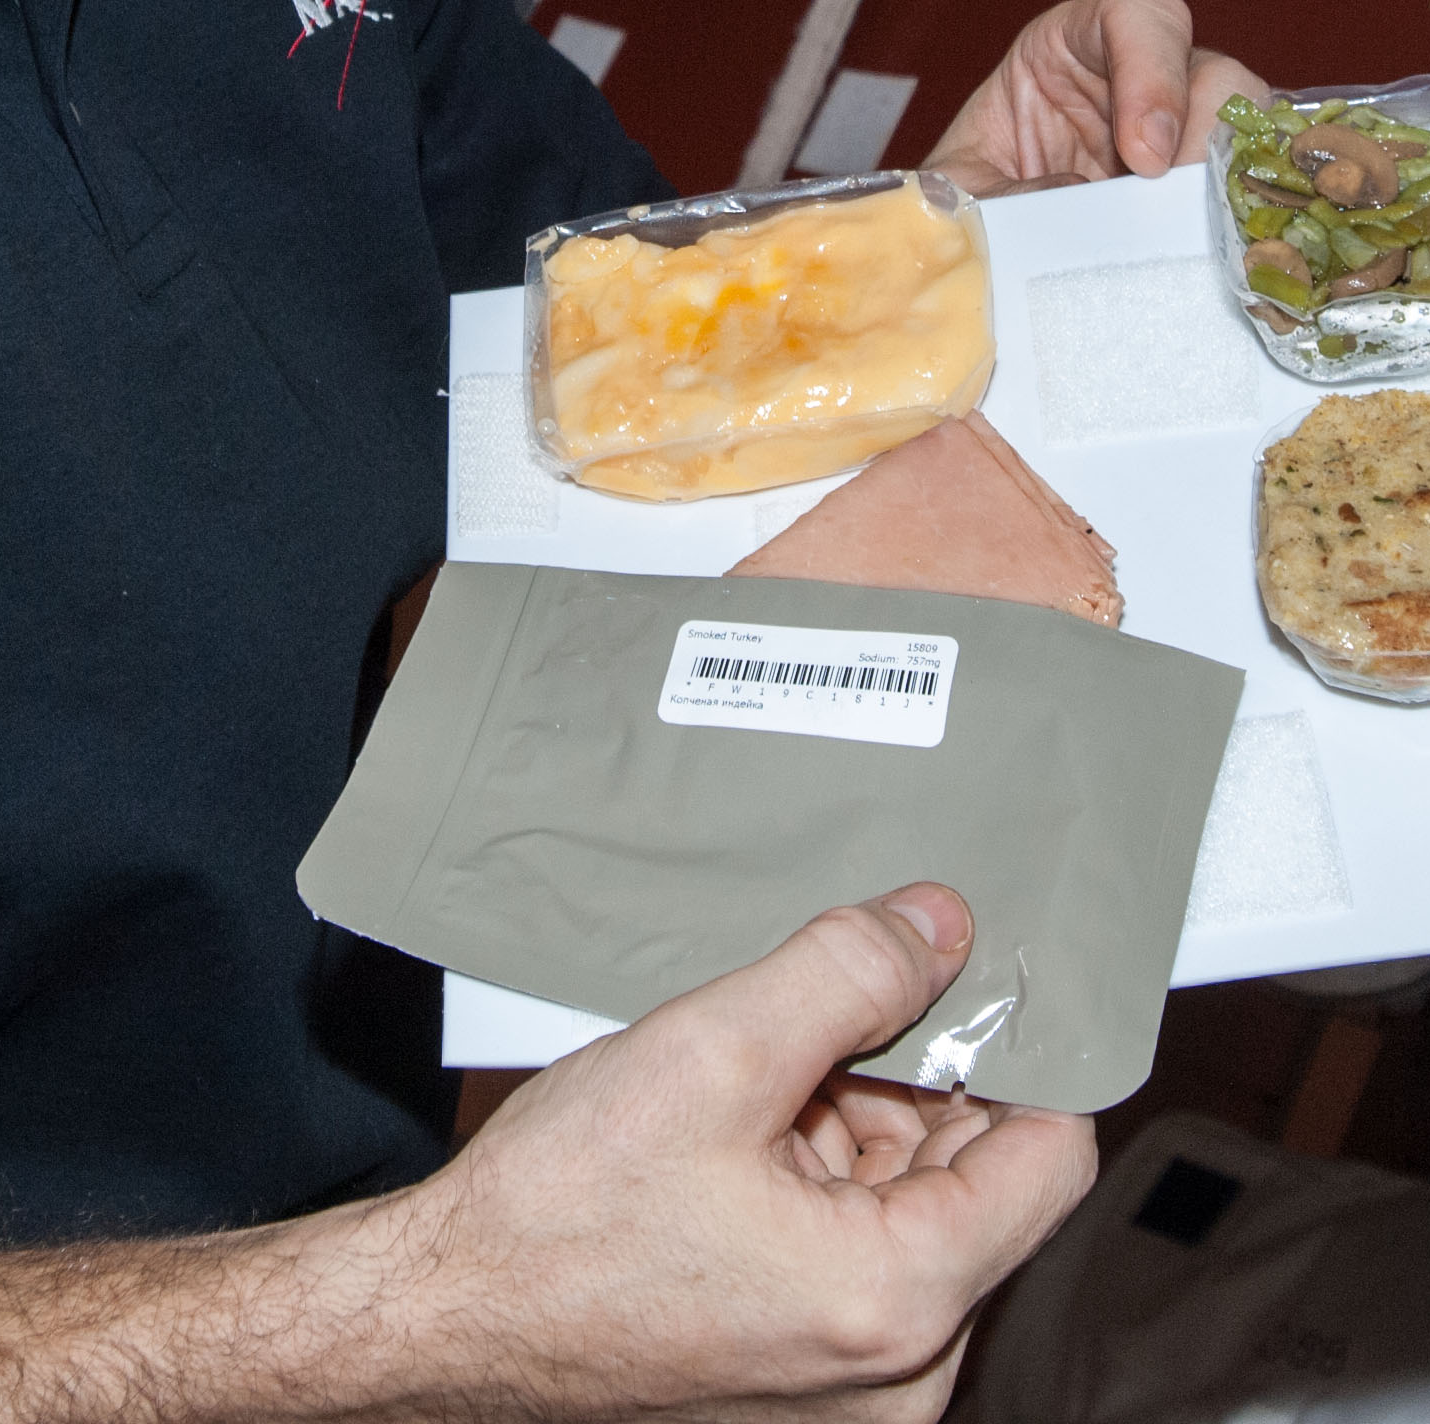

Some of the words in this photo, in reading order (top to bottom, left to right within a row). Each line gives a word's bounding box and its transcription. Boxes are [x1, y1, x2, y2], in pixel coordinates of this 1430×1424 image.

[687, 628, 727, 641] Smoked
[730, 632, 764, 644] Turkey
[906, 642, 939, 654] 15809
[858, 652, 900, 665] Sodium:
[906, 654, 941, 669] 757mg
[669, 694, 720, 707] Копченая
[721, 696, 764, 711] индейка
